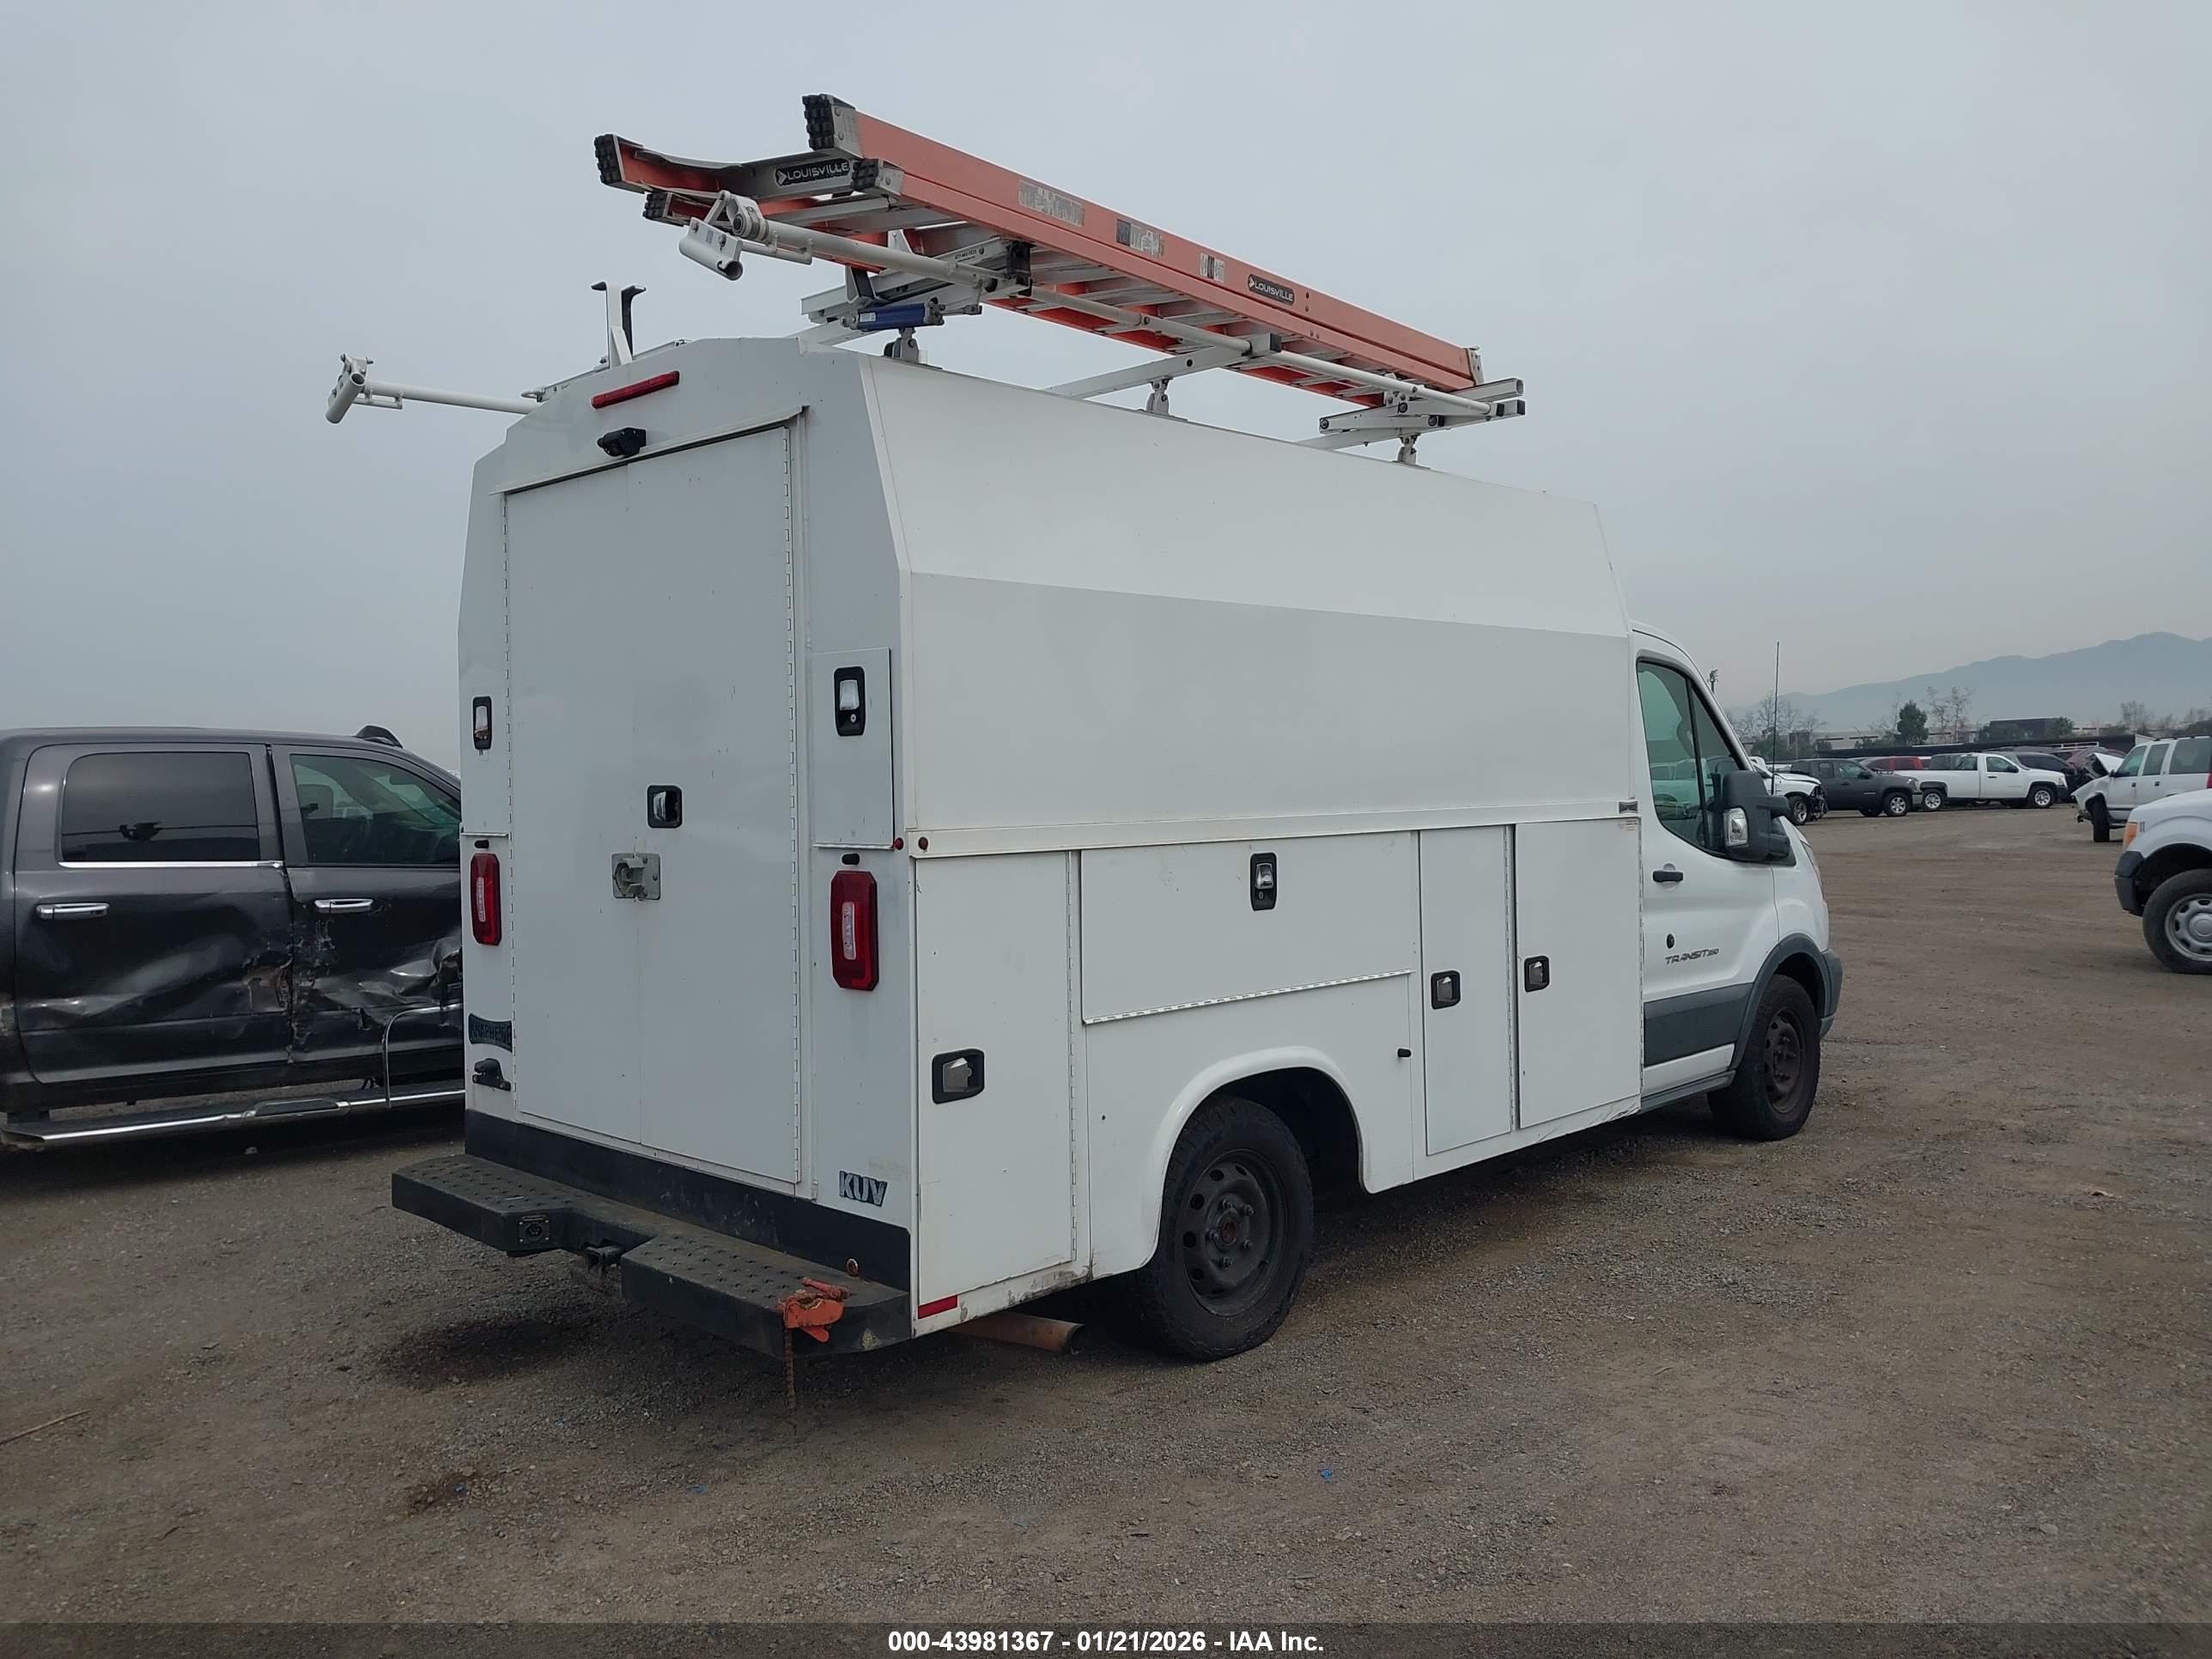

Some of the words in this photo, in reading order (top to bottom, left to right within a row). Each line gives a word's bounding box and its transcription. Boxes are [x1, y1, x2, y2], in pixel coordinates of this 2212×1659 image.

[787, 161, 850, 180] LOUISVILLE
[1255, 281, 1293, 301] LOUISVILLE
[1665, 949, 1708, 964] TRANSIT
[840, 1170, 888, 1206] KUV
